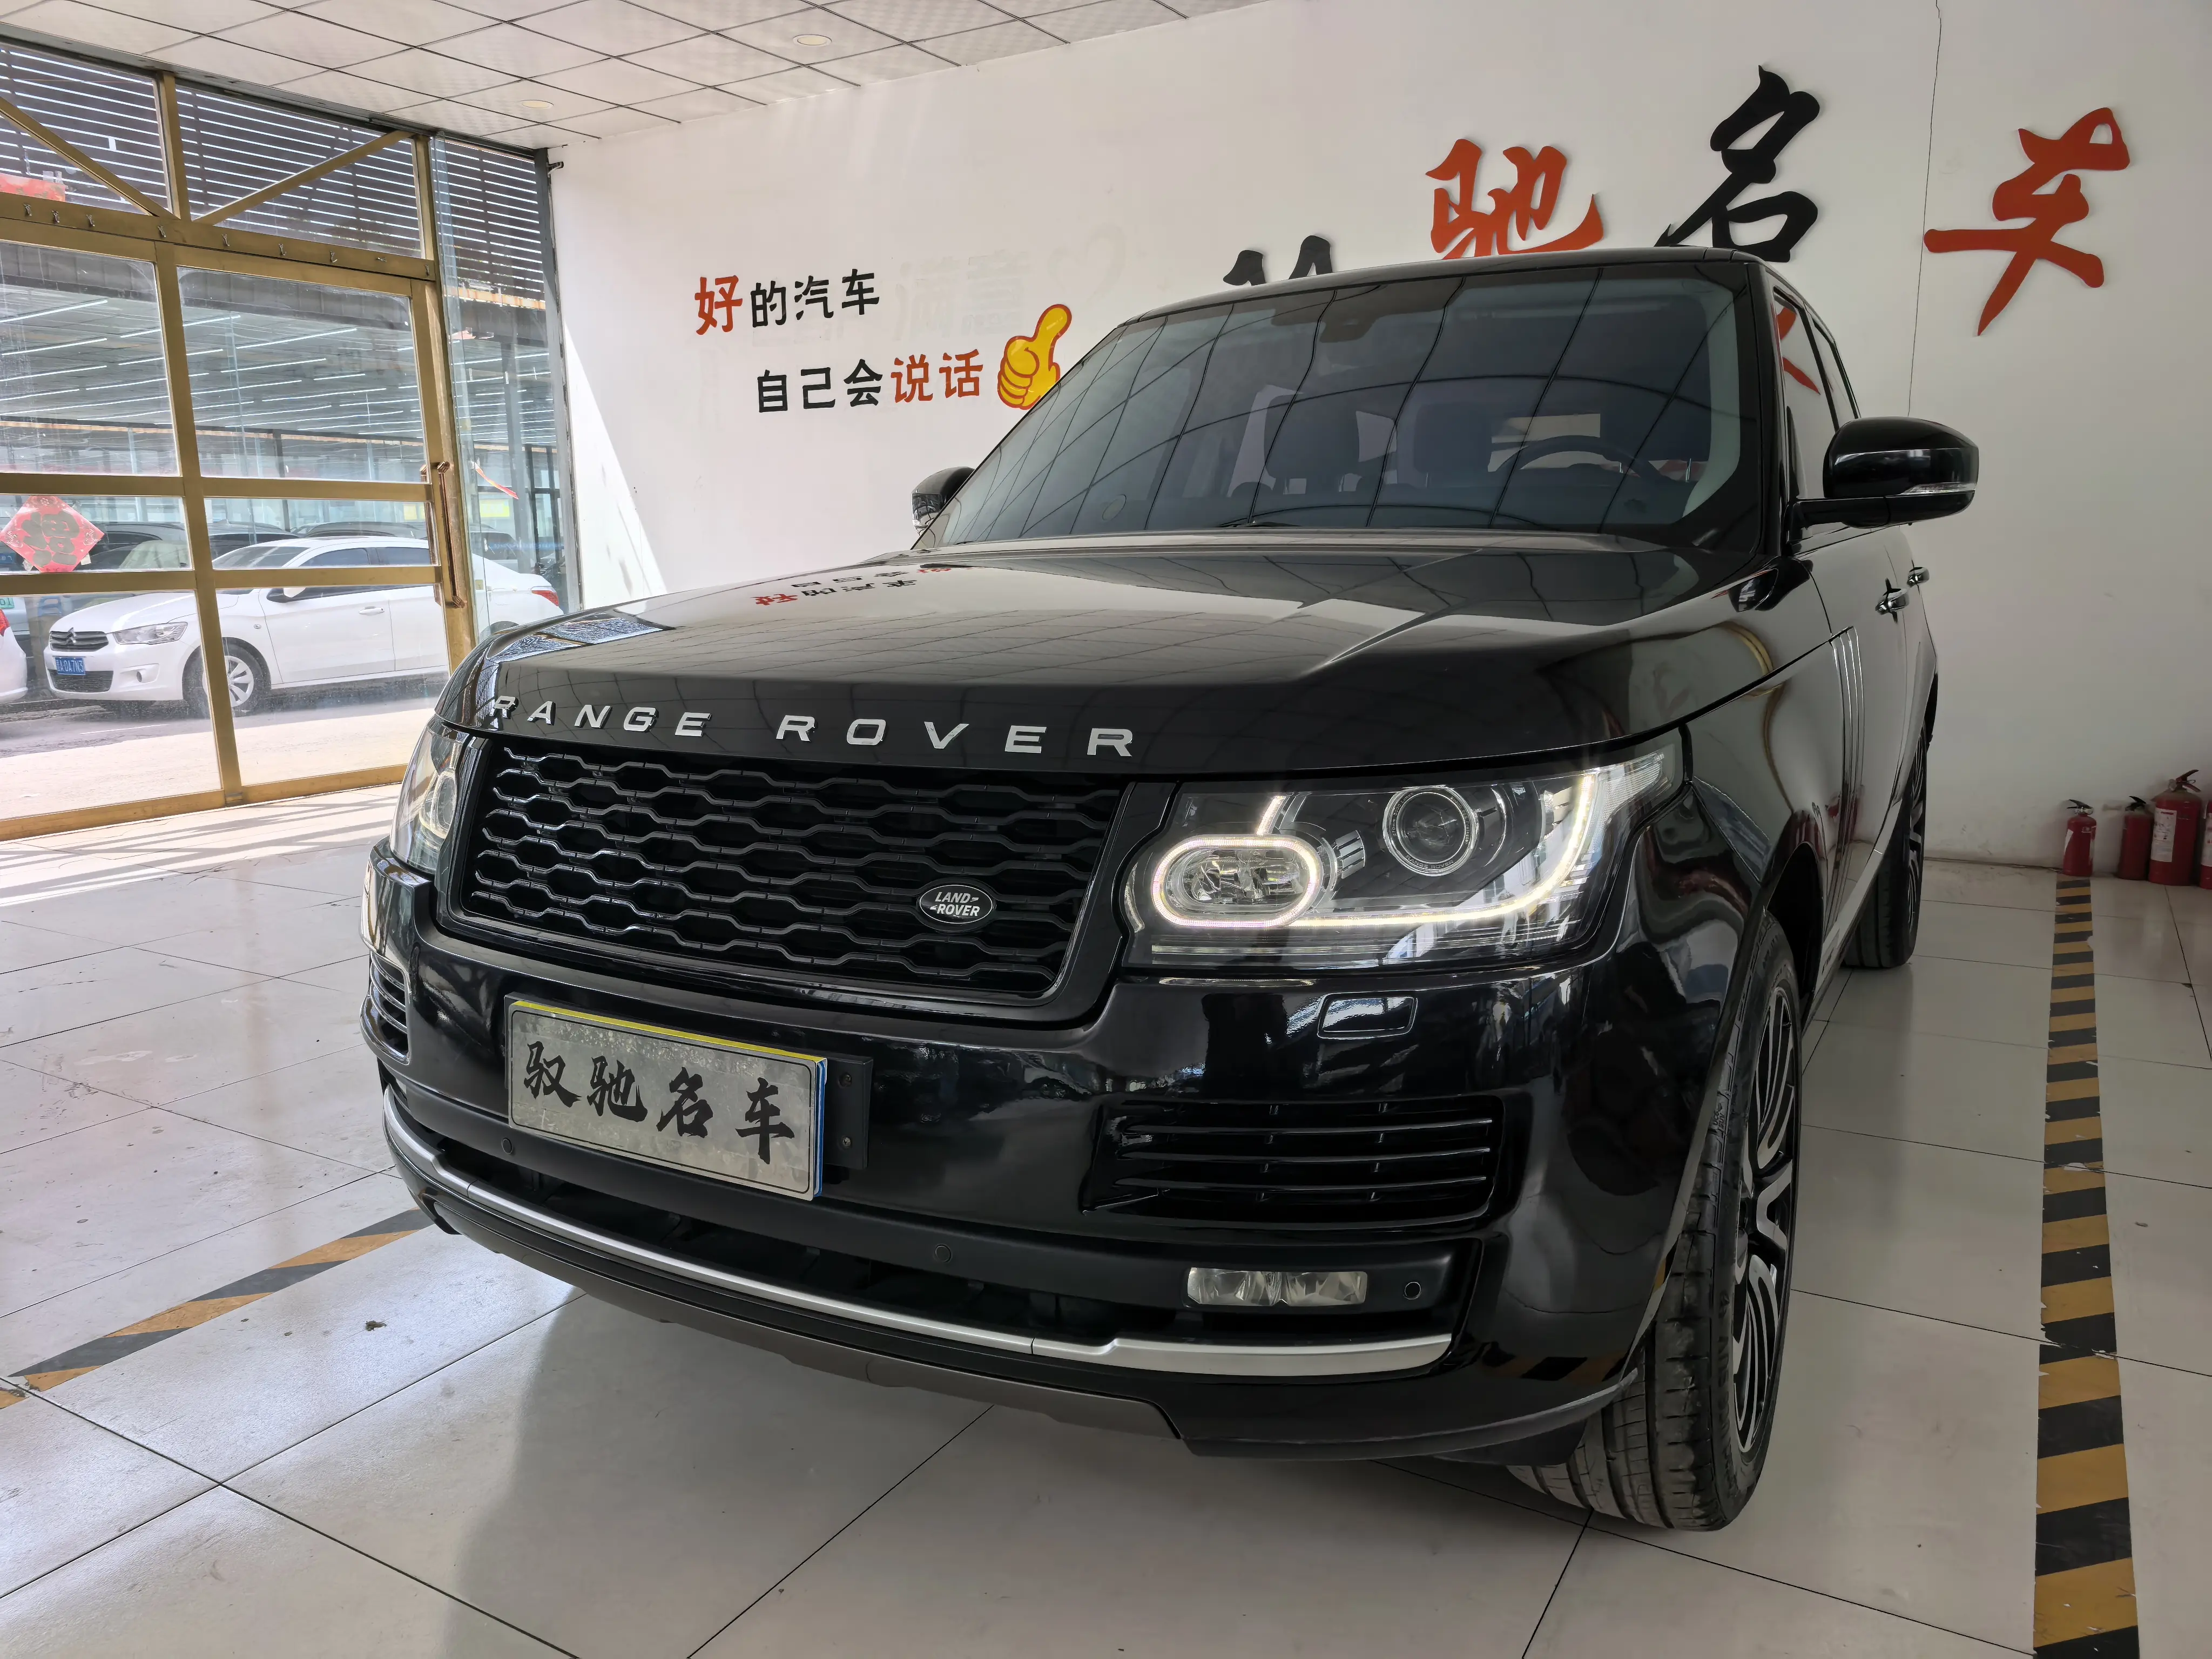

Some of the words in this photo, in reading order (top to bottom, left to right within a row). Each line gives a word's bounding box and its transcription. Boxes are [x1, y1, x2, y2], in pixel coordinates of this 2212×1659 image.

[1223, 64, 2130, 336] 驰名车
[694, 268, 880, 335] 好的汽车
[757, 349, 984, 413] 自己会说话
[492, 695, 712, 737] RANGE
[776, 714, 1133, 757] ROVER
[1406, 854, 1428, 868] RANGE
[1430, 860, 1454, 869] ROVER
[935, 892, 971, 903] LAND
[936, 903, 980, 916] ROVER
[523, 1041, 795, 1164] 驭驰名车
